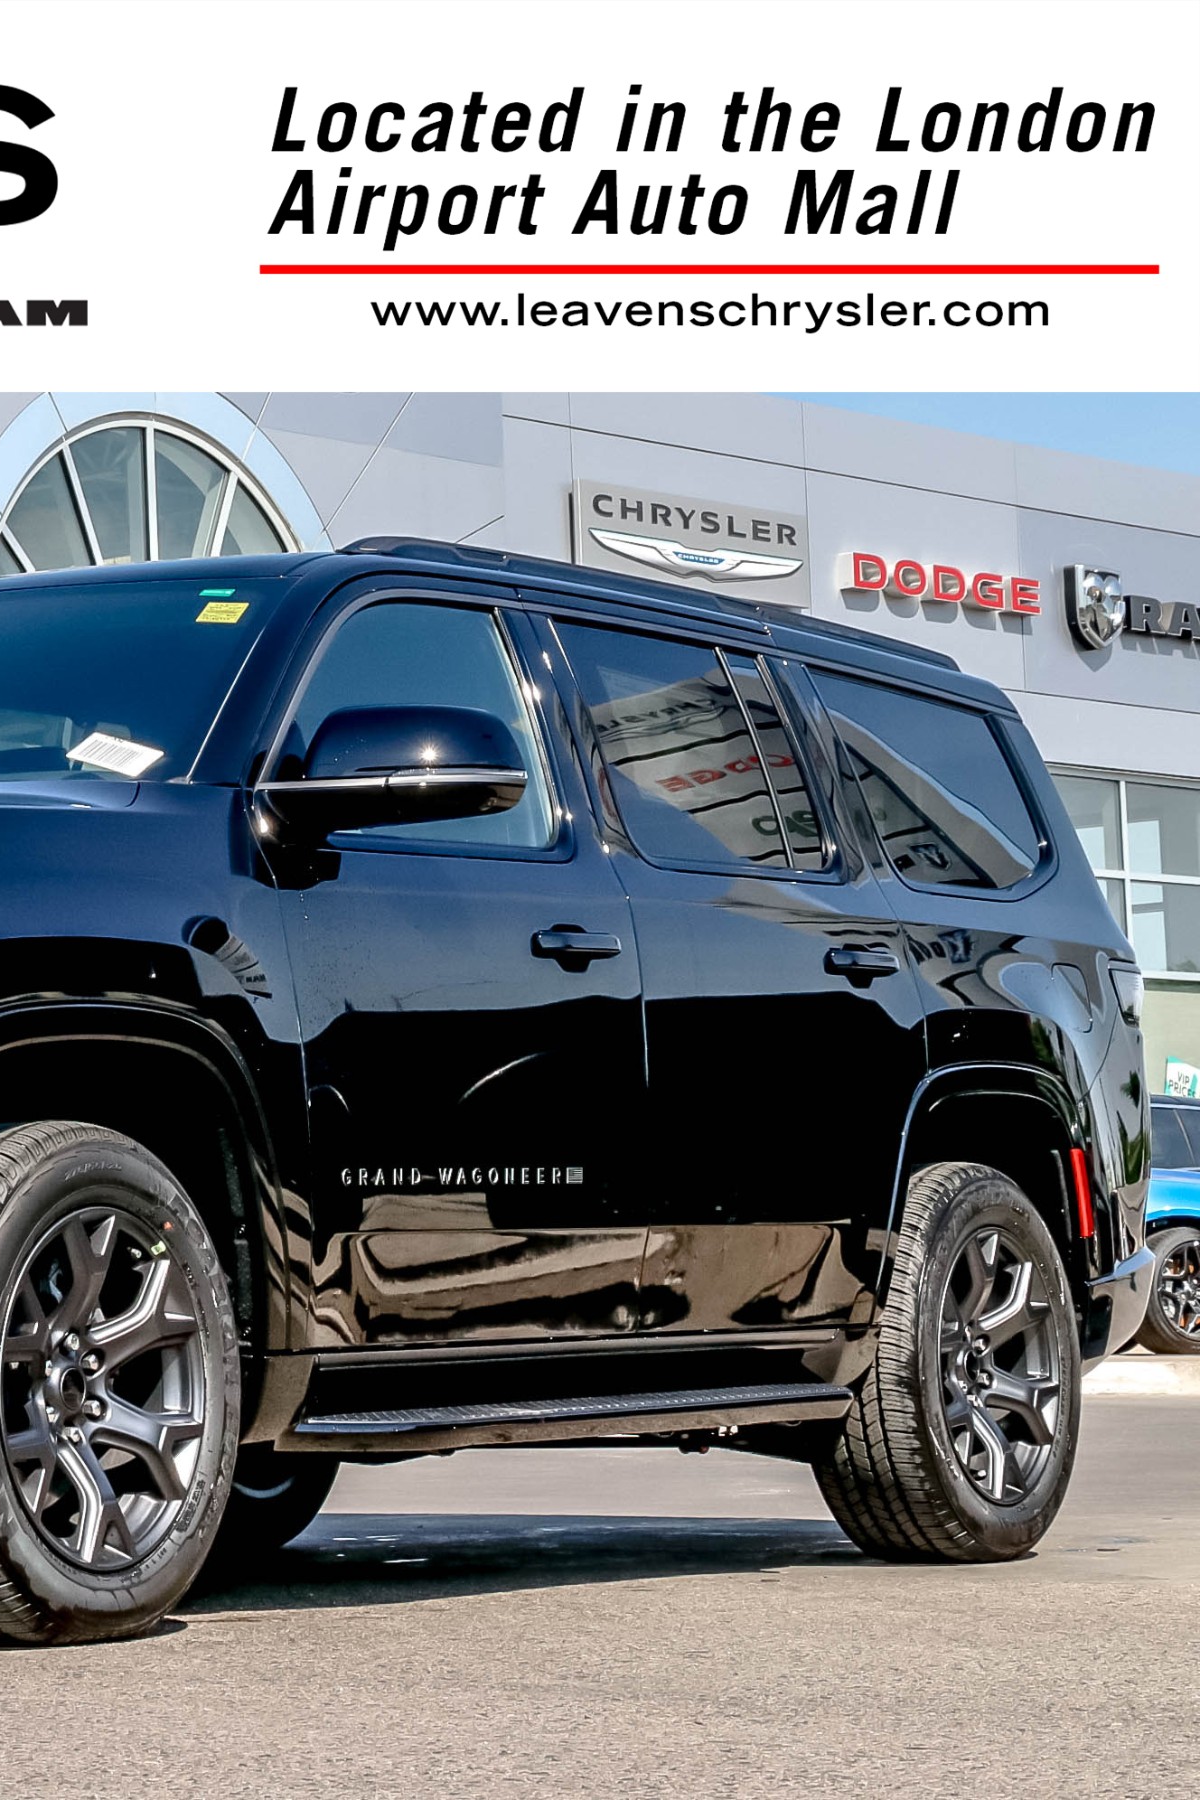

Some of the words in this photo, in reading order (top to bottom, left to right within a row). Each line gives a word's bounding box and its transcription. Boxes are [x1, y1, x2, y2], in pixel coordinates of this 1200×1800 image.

[592, 494, 797, 546] CHRYSLER
[852, 552, 1041, 614] DODGE
[1123, 595, 1200, 640] RA
[1177, 1071, 1190, 1085] VIP
[341, 1167, 421, 1186] GRAND
[438, 1167, 562, 1185] WAGONEER
